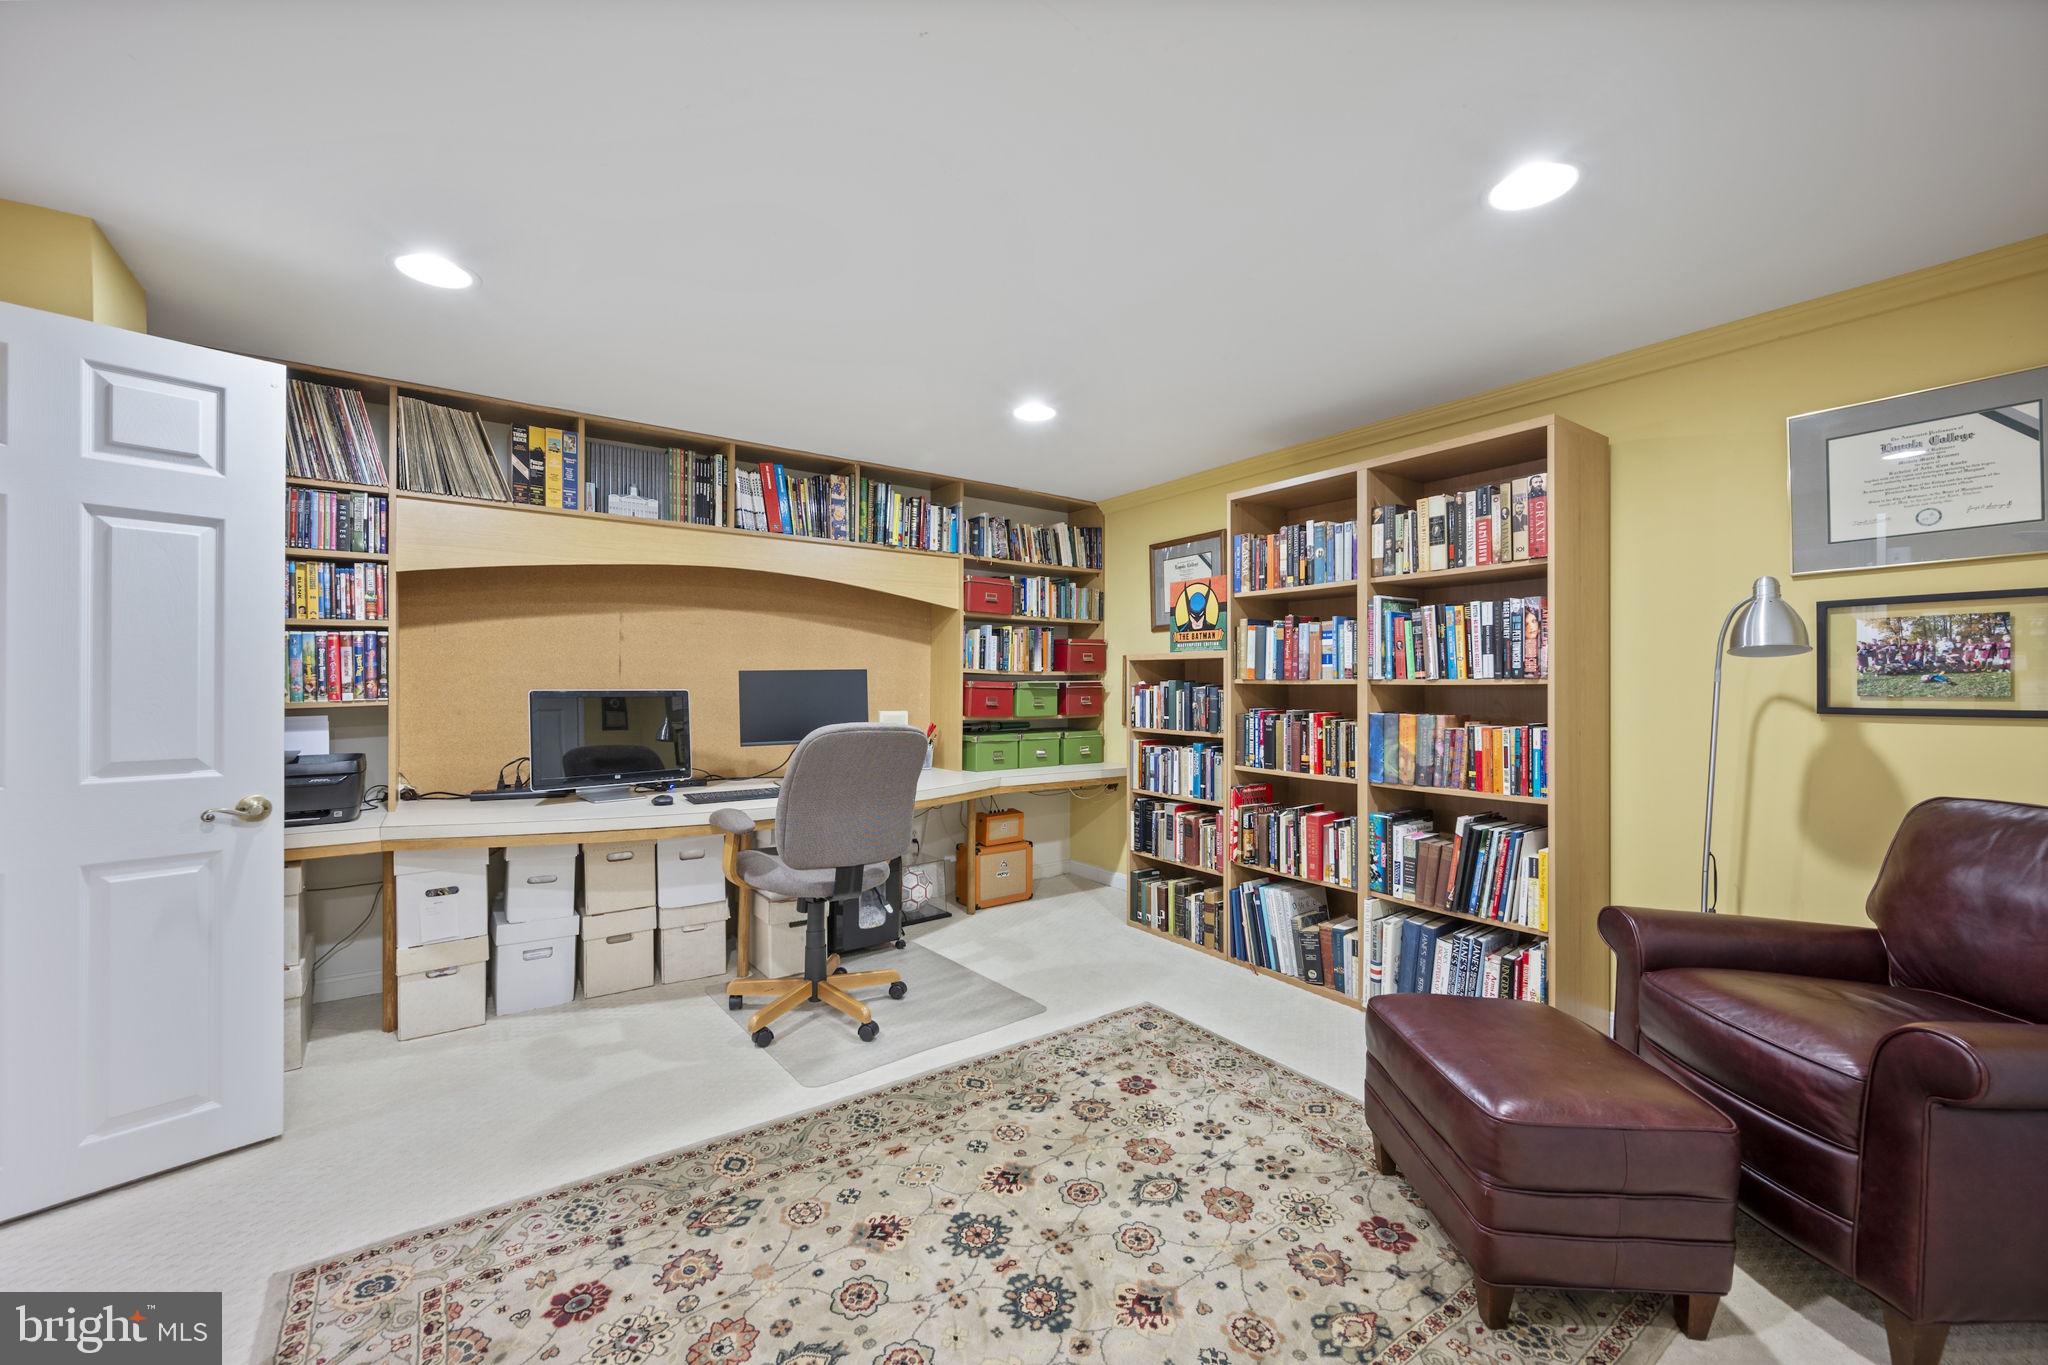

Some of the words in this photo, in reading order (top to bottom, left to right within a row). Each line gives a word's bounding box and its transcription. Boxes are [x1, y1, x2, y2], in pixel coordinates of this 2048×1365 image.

[1928, 432, 1975, 446] College
[339, 505, 348, 538] HEROES
[1536, 501, 1545, 543] GRANT
[1502, 521, 1510, 555] ADAMS
[1192, 632, 1215, 640] BATMAN
[1512, 630, 1521, 641] PETE
[1435, 945, 1443, 983] ENCYCLOPEDIA
[1451, 939, 1460, 964] JANE'S
[1460, 940, 1469, 971] JANE'S
[1471, 944, 1481, 972] JANE'S
